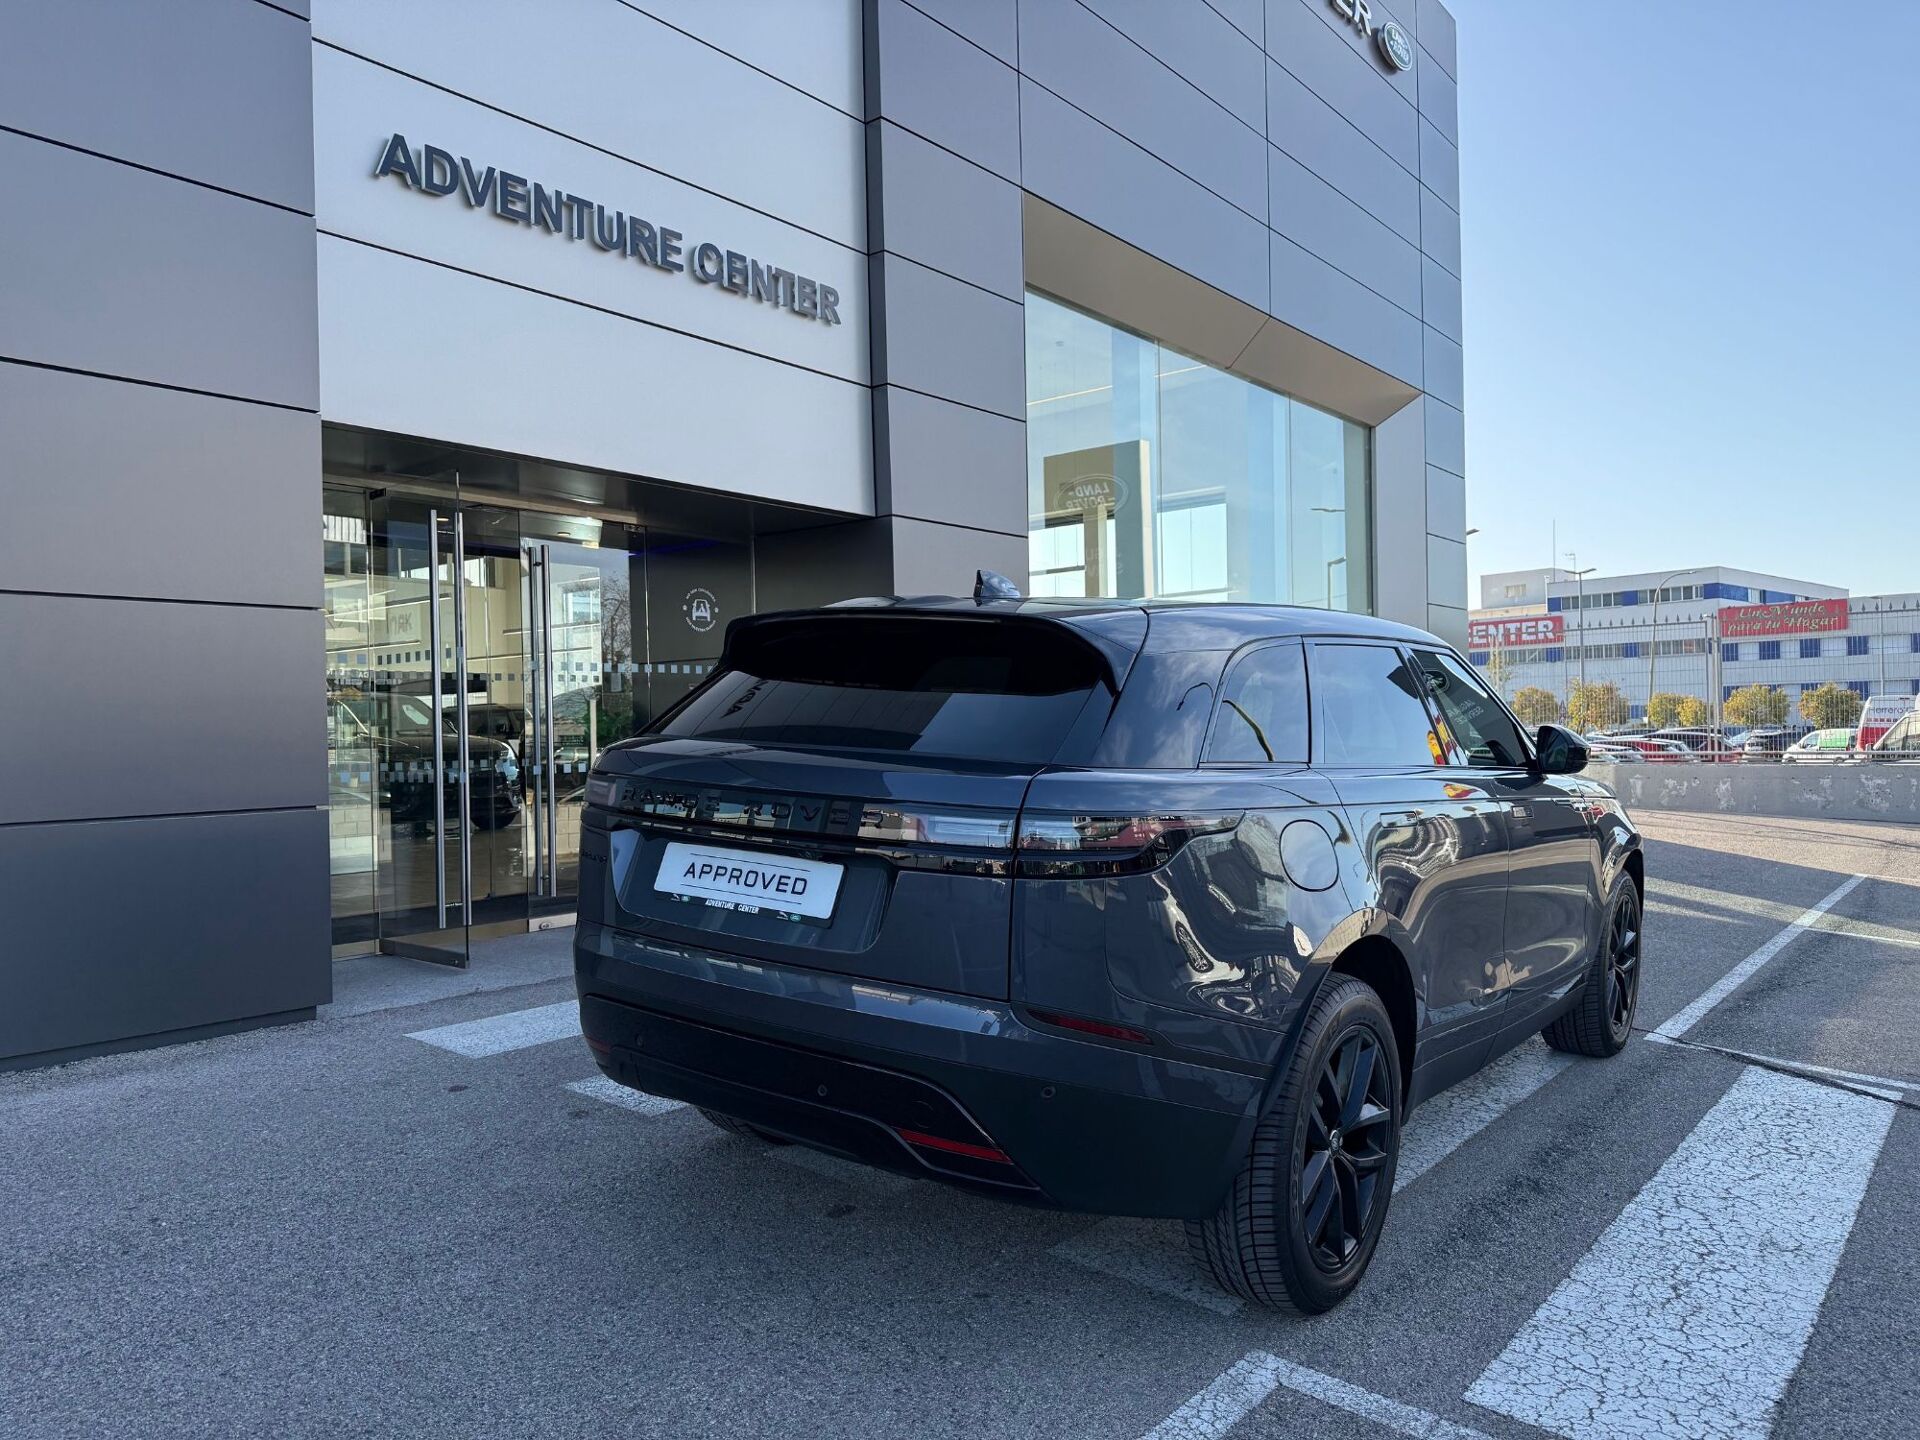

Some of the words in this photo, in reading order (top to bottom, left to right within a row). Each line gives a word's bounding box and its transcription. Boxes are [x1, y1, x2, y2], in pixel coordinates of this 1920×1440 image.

[377, 132, 684, 273] ADVENTURE
[693, 241, 842, 325] CENTER
[1469, 620, 1555, 644] ENTER
[683, 861, 808, 896] APPROVED
[705, 899, 735, 910] ADVENTURE
[737, 904, 760, 915] CENTER
